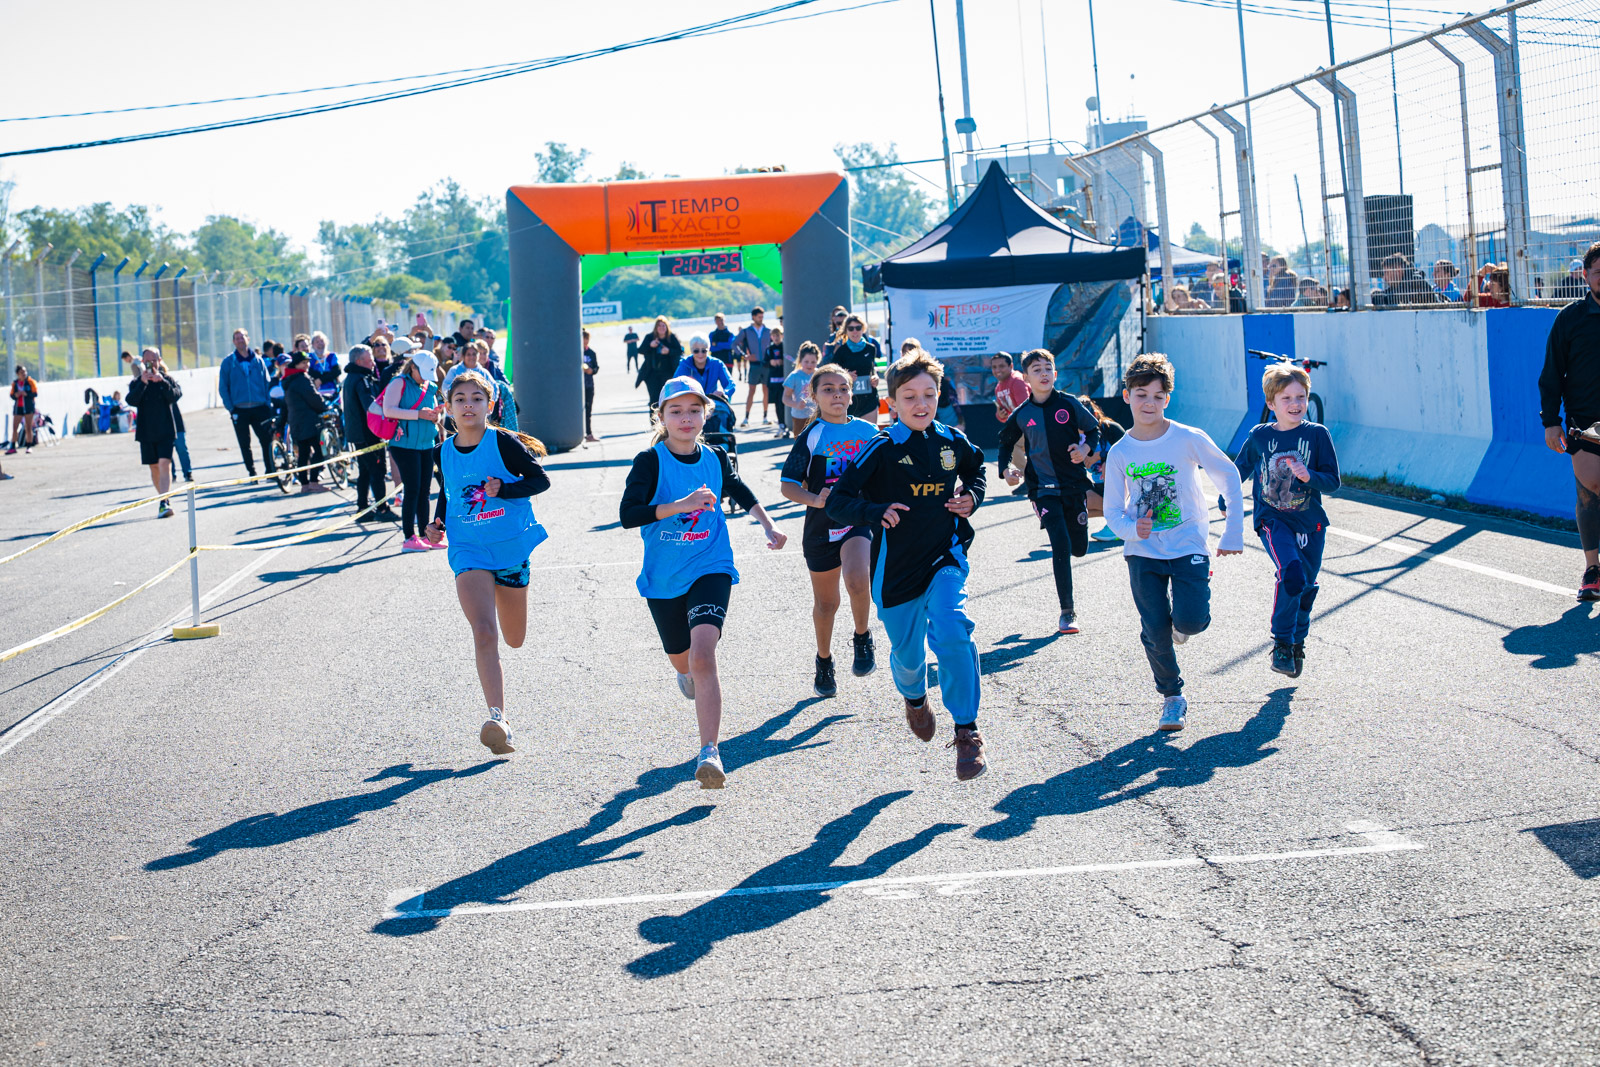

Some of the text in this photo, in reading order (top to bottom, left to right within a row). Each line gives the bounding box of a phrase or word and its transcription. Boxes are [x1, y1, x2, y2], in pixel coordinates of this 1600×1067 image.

[640, 196, 739, 233] TIEMPO
[656, 205, 741, 233] EXACTO
[672, 253, 740, 275] 2:05:25
[939, 304, 1000, 328] TIEMPO
[1126, 461, 1170, 478] Custom
[910, 483, 945, 497] YPF
